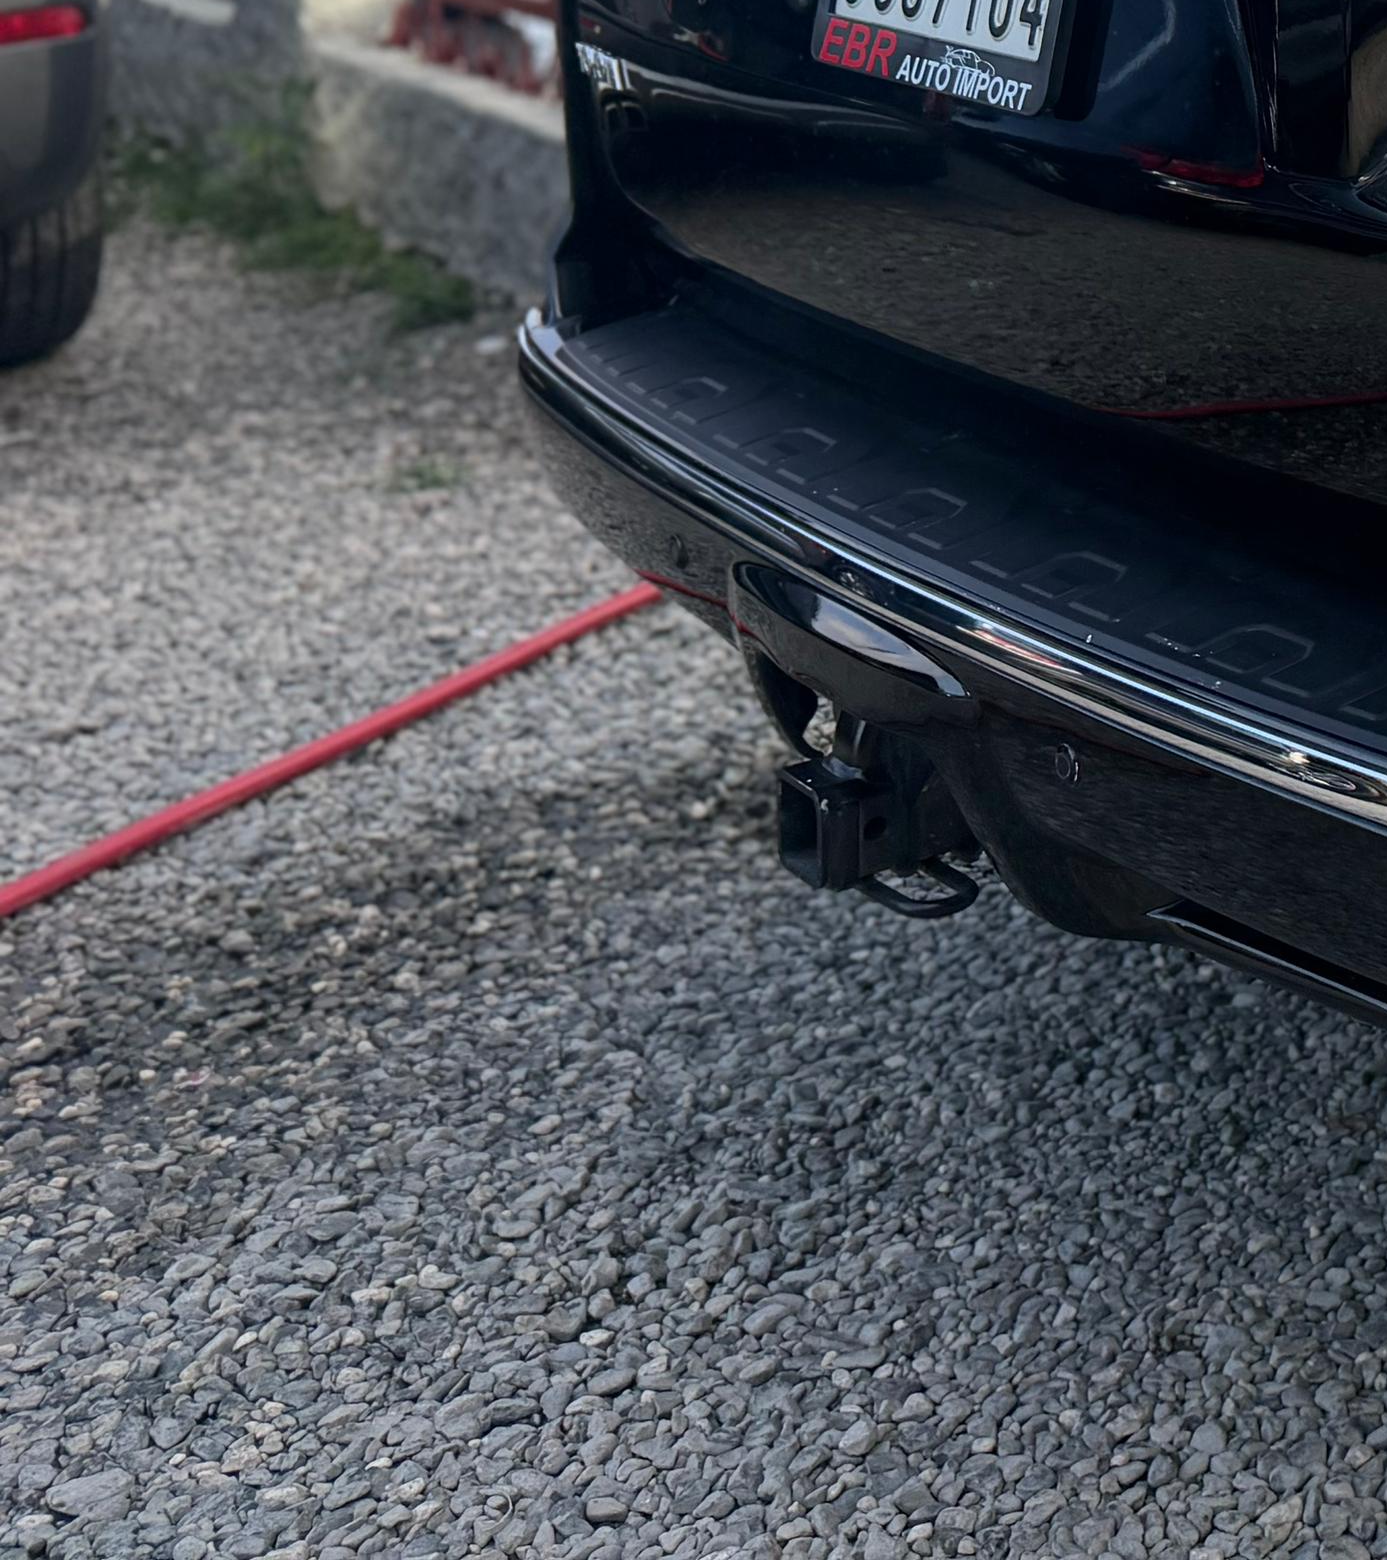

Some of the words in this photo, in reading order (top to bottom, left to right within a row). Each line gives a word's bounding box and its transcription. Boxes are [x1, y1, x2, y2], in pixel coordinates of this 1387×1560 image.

[818, 16, 897, 77] EBR
[896, 54, 950, 91] AUTO
[952, 68, 1033, 111] IMPORT
